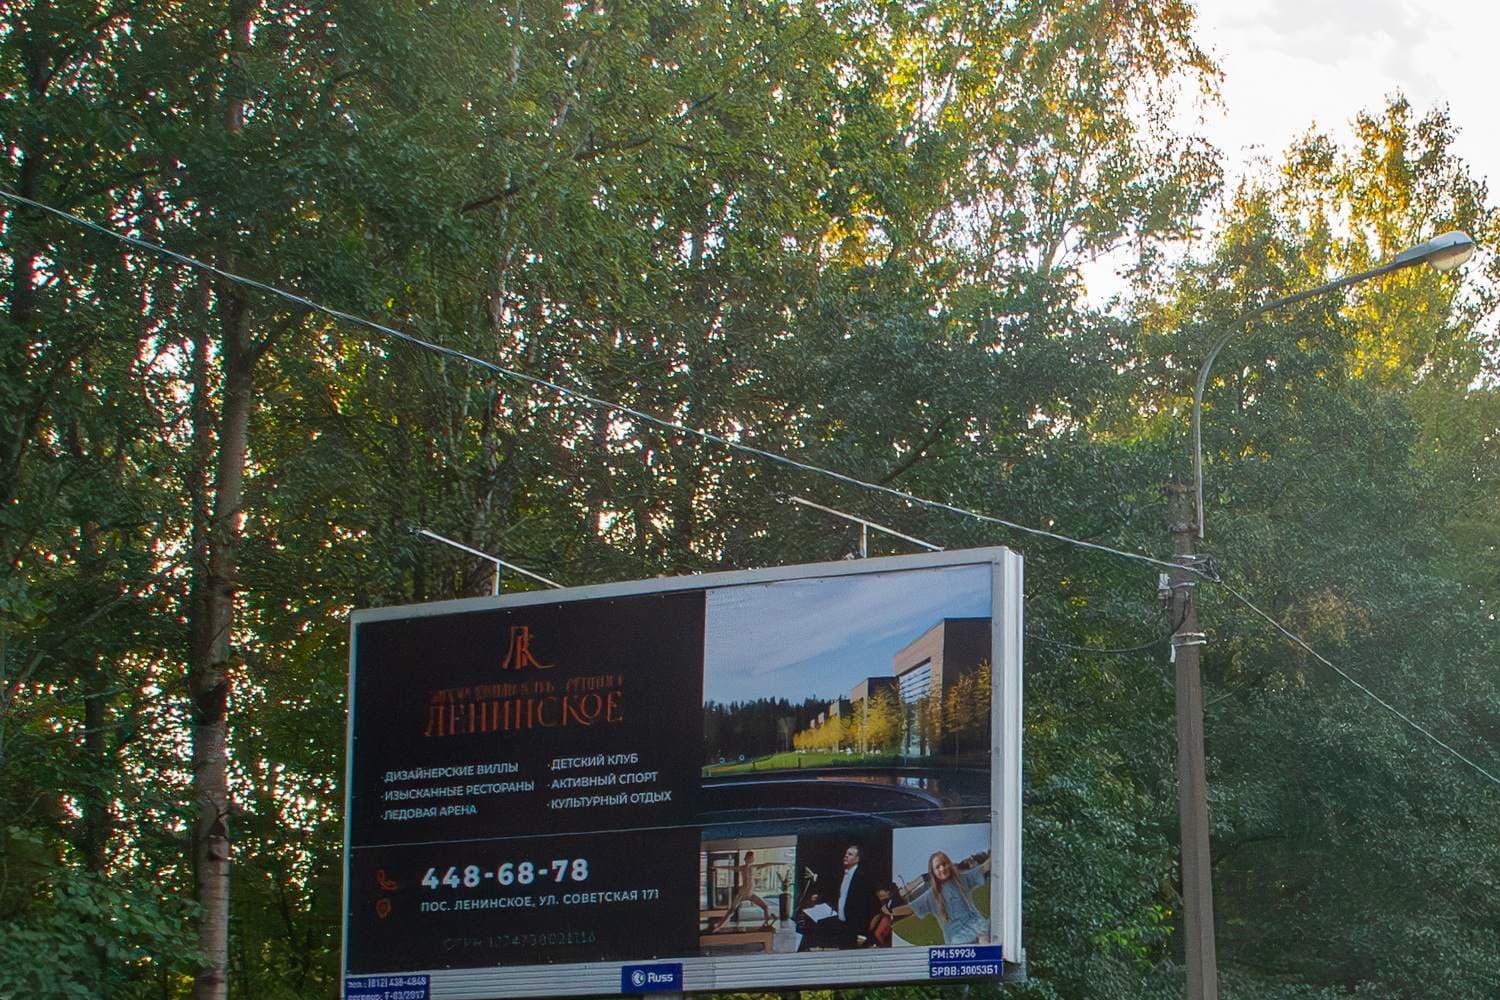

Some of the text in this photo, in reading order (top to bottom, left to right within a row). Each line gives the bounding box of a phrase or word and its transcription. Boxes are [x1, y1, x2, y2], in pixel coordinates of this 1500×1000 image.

[424, 690, 624, 737] ЛЕНИНСКОЕ
[551, 753, 639, 771] ДЕТСКИЙ КЛУБ
[384, 762, 519, 783] ДИЗАЙНЕРСКИЕ ВИЛЛЫ
[551, 771, 659, 789] АКТИВНЫЙ СПОРТ
[385, 780, 535, 800] ИЗЫСКАННЫЕ РЕСТОРАНЫ
[551, 791, 672, 809] КУЛЬТУРНЫЙ ОТДЫХ
[384, 804, 478, 821] ЛЕДОВАЯ АРЕНА
[421, 858, 589, 889] 448-68-78
[421, 901, 451, 912] ПОС.
[454, 896, 536, 911] ЛЕНИНСКОЕ,
[539, 894, 559, 907] УЛ.
[563, 889, 638, 905] СОВЕТСКАЯ
[647, 972, 674, 983] Russ
